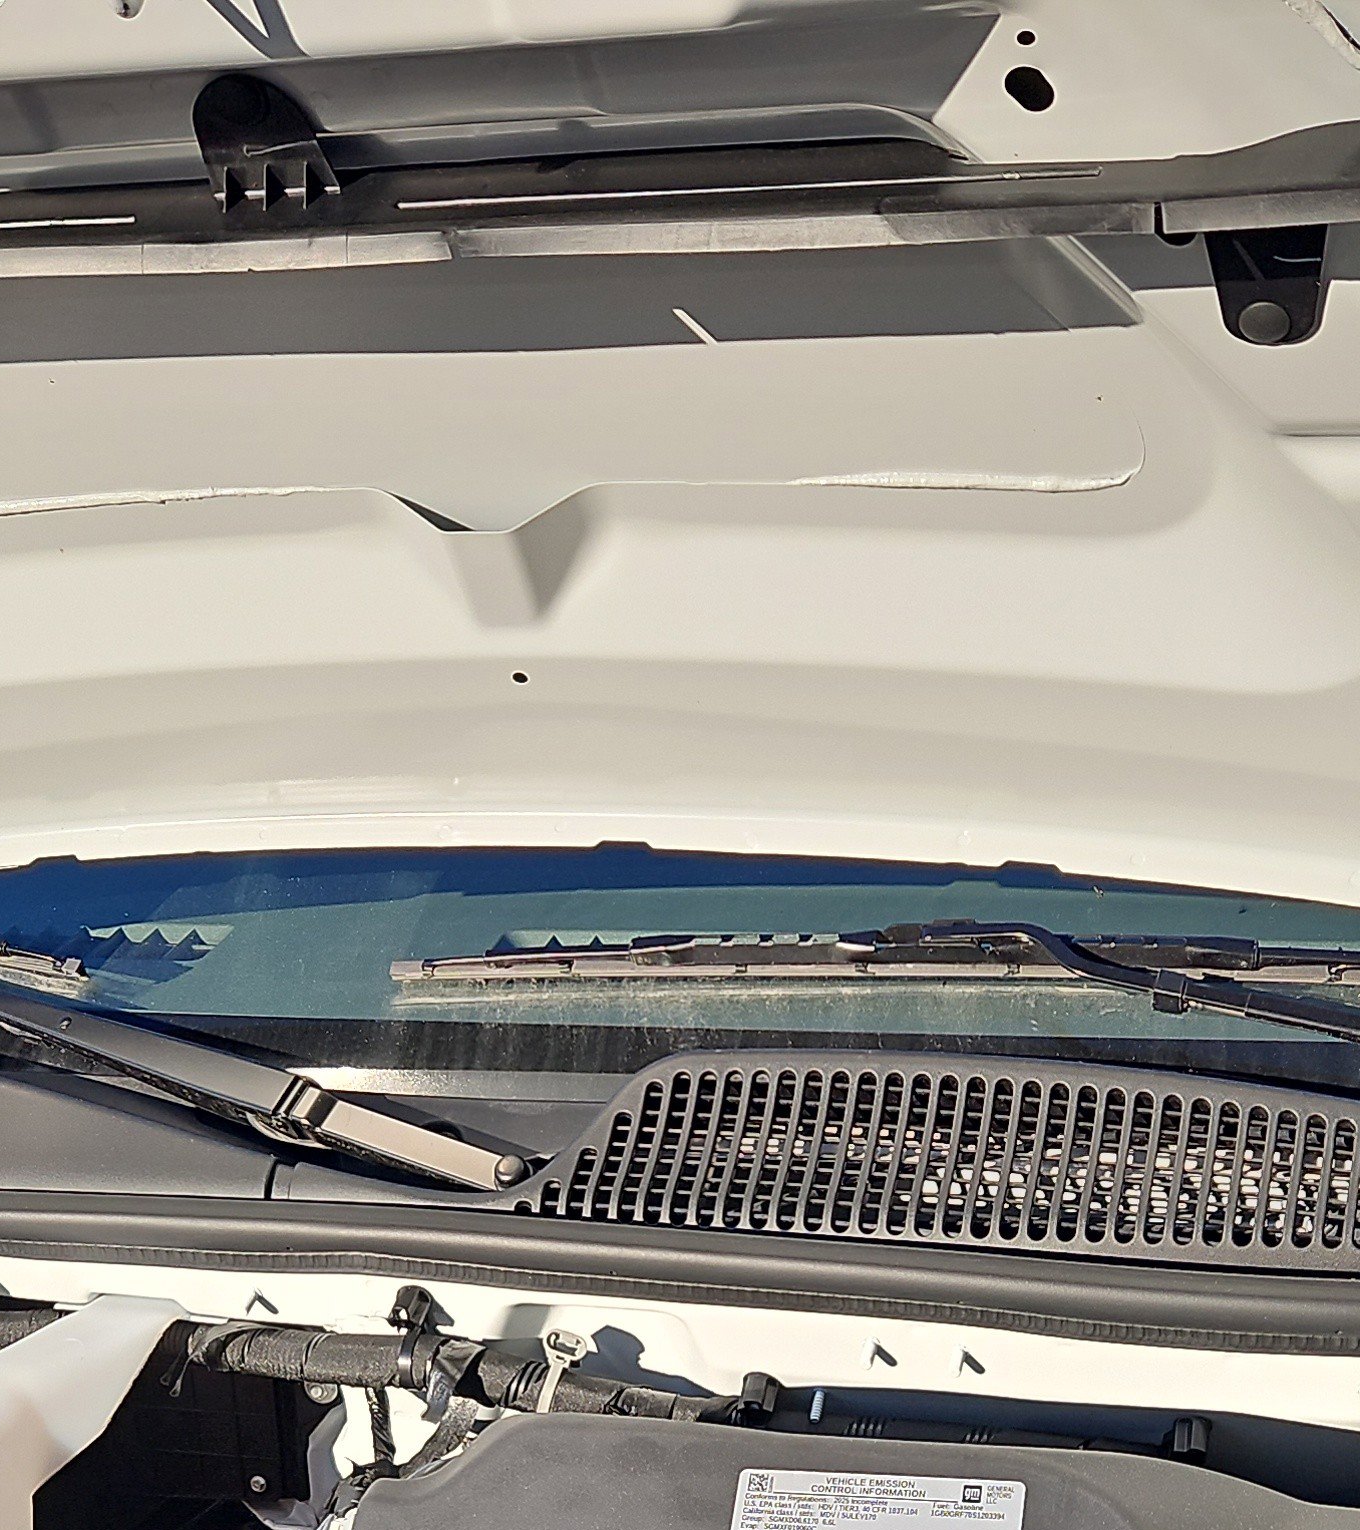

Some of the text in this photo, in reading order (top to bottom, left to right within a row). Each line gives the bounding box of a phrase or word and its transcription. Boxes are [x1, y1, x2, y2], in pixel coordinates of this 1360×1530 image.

[826, 1477, 915, 1488] VEHICLE EMISSION
[811, 1485, 926, 1497] CONTROL INFORMATION
